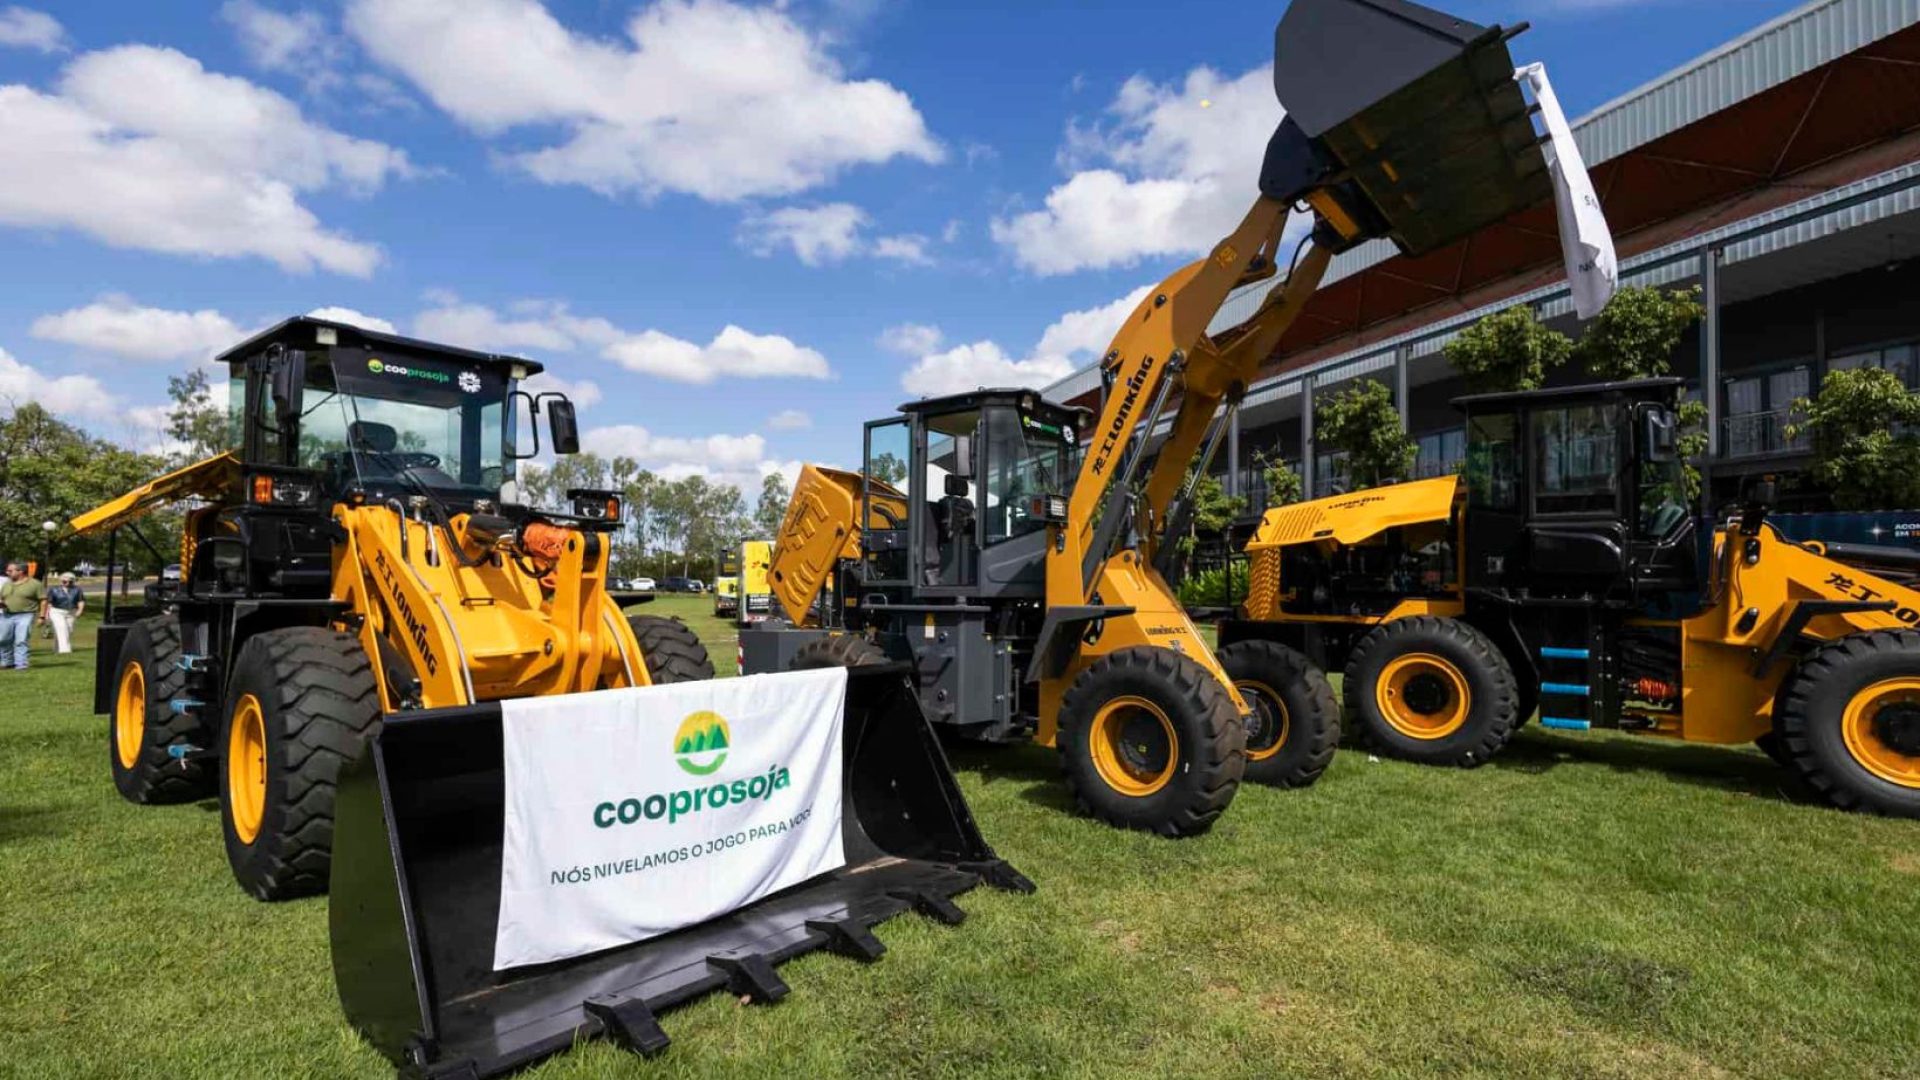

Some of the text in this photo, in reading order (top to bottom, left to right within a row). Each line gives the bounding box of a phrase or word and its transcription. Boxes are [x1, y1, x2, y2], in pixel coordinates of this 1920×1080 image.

[384, 364, 450, 383] cooprosoja
[593, 764, 791, 828] cooprosoja
[551, 866, 591, 885] NÓS
[594, 847, 689, 879] NIVELAMOS
[691, 844, 703, 858] O
[705, 832, 747, 854] JOGO
[749, 820, 788, 842] PARA
